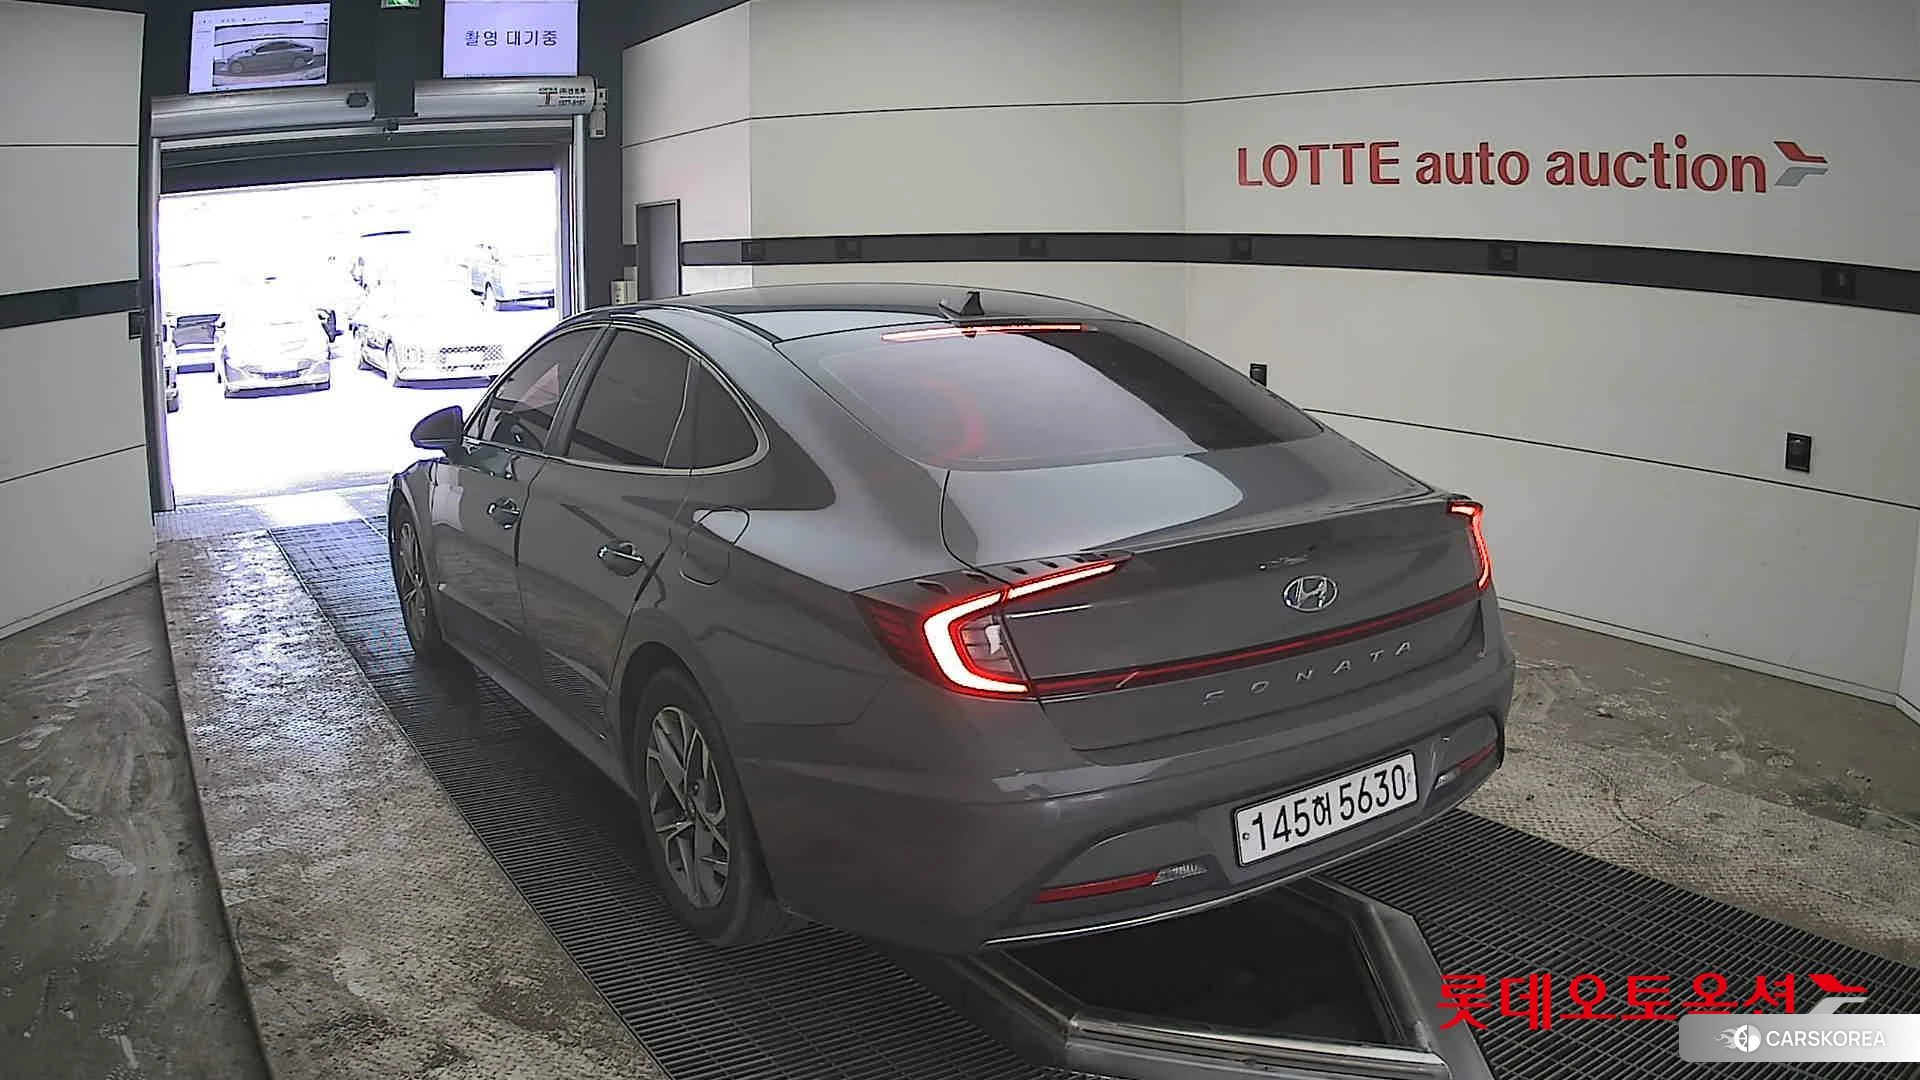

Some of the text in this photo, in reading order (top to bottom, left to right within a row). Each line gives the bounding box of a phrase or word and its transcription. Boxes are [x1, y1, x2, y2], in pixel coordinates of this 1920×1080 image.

[466, 30, 557, 46] 촬영 대기중
[1237, 134, 1767, 193] LOTTE auto auction
[1202, 641, 1411, 704] SONATA
